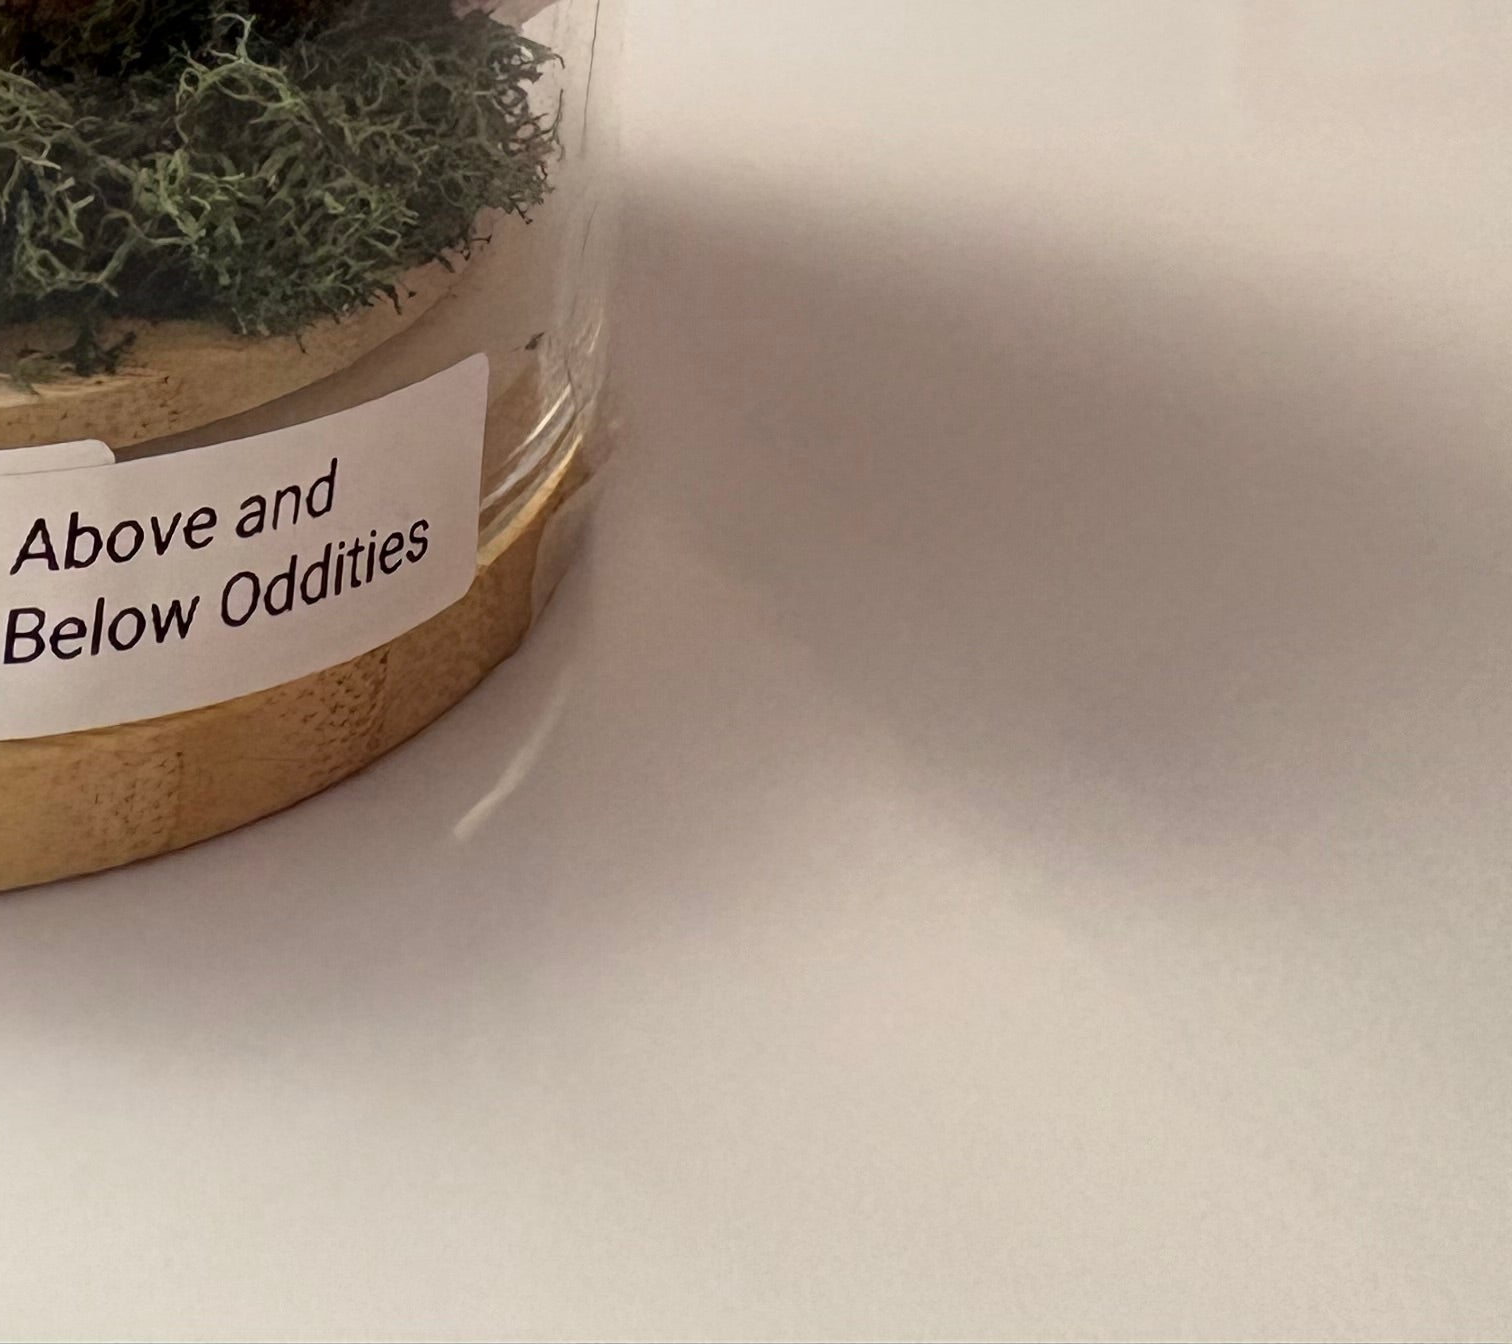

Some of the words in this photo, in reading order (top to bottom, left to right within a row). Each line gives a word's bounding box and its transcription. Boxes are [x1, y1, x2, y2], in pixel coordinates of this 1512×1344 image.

[8, 494, 219, 577] Above
[234, 457, 339, 540] and
[2, 595, 202, 667] Below
[219, 516, 431, 629] Oddities
